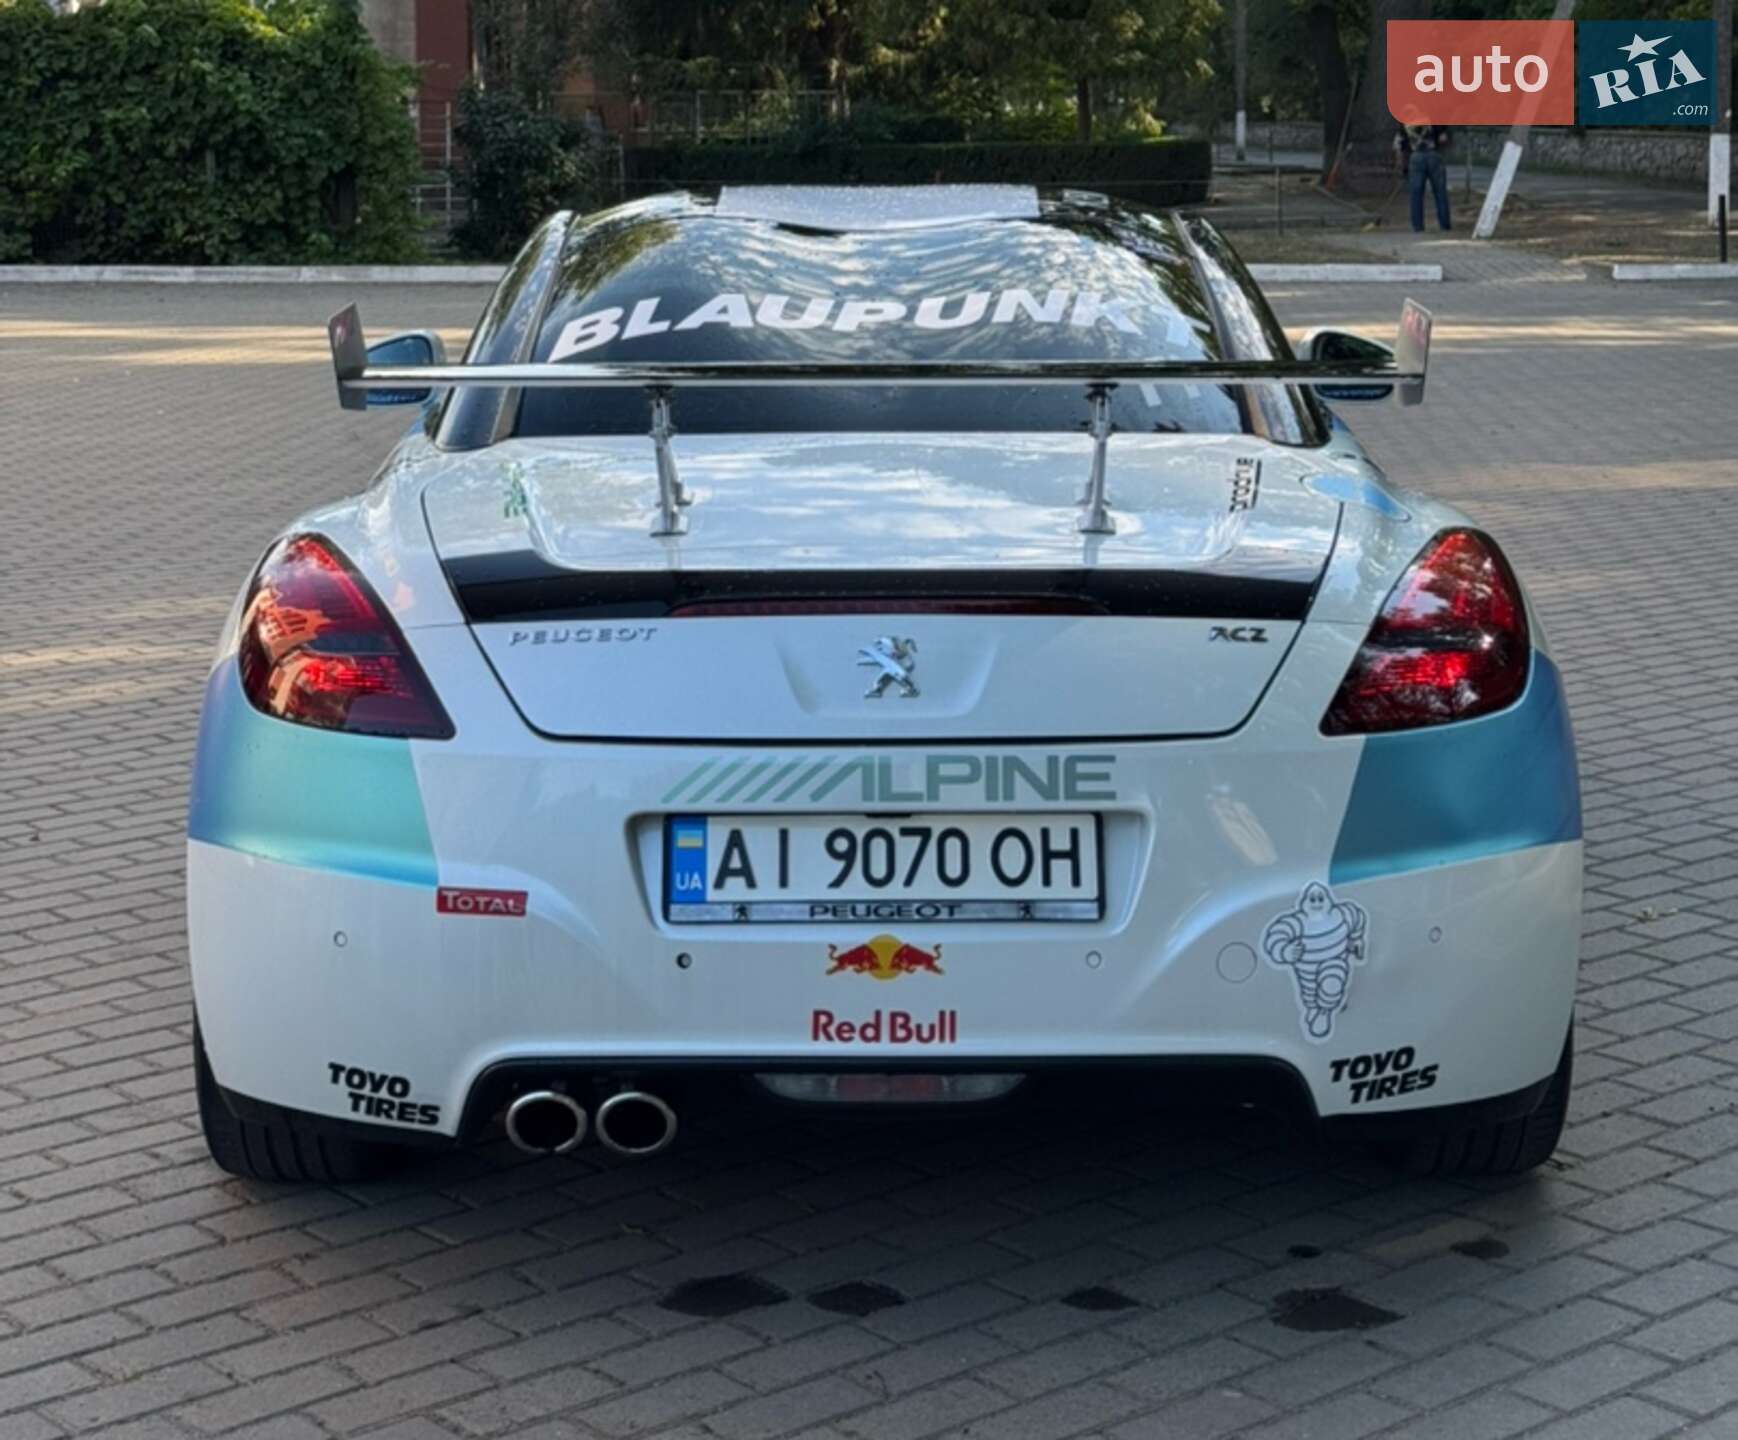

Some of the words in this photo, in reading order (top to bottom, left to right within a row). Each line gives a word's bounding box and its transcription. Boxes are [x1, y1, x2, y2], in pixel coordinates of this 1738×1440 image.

[511, 627, 657, 646] PEUGEOT
[809, 755, 1116, 802] ALPINE
[713, 828, 789, 890] AI
[824, 827, 971, 888] 9070
[991, 827, 1082, 888] OH
[676, 872, 703, 891] UA
[809, 904, 962, 919] PEUGEOT
[811, 1009, 881, 1043] Red
[889, 1010, 957, 1043] Bull
[328, 1062, 411, 1099] TOYO
[1329, 1046, 1415, 1083] TOYO
[1349, 1063, 1439, 1105] TIRES
[347, 1091, 441, 1125] TIRES
